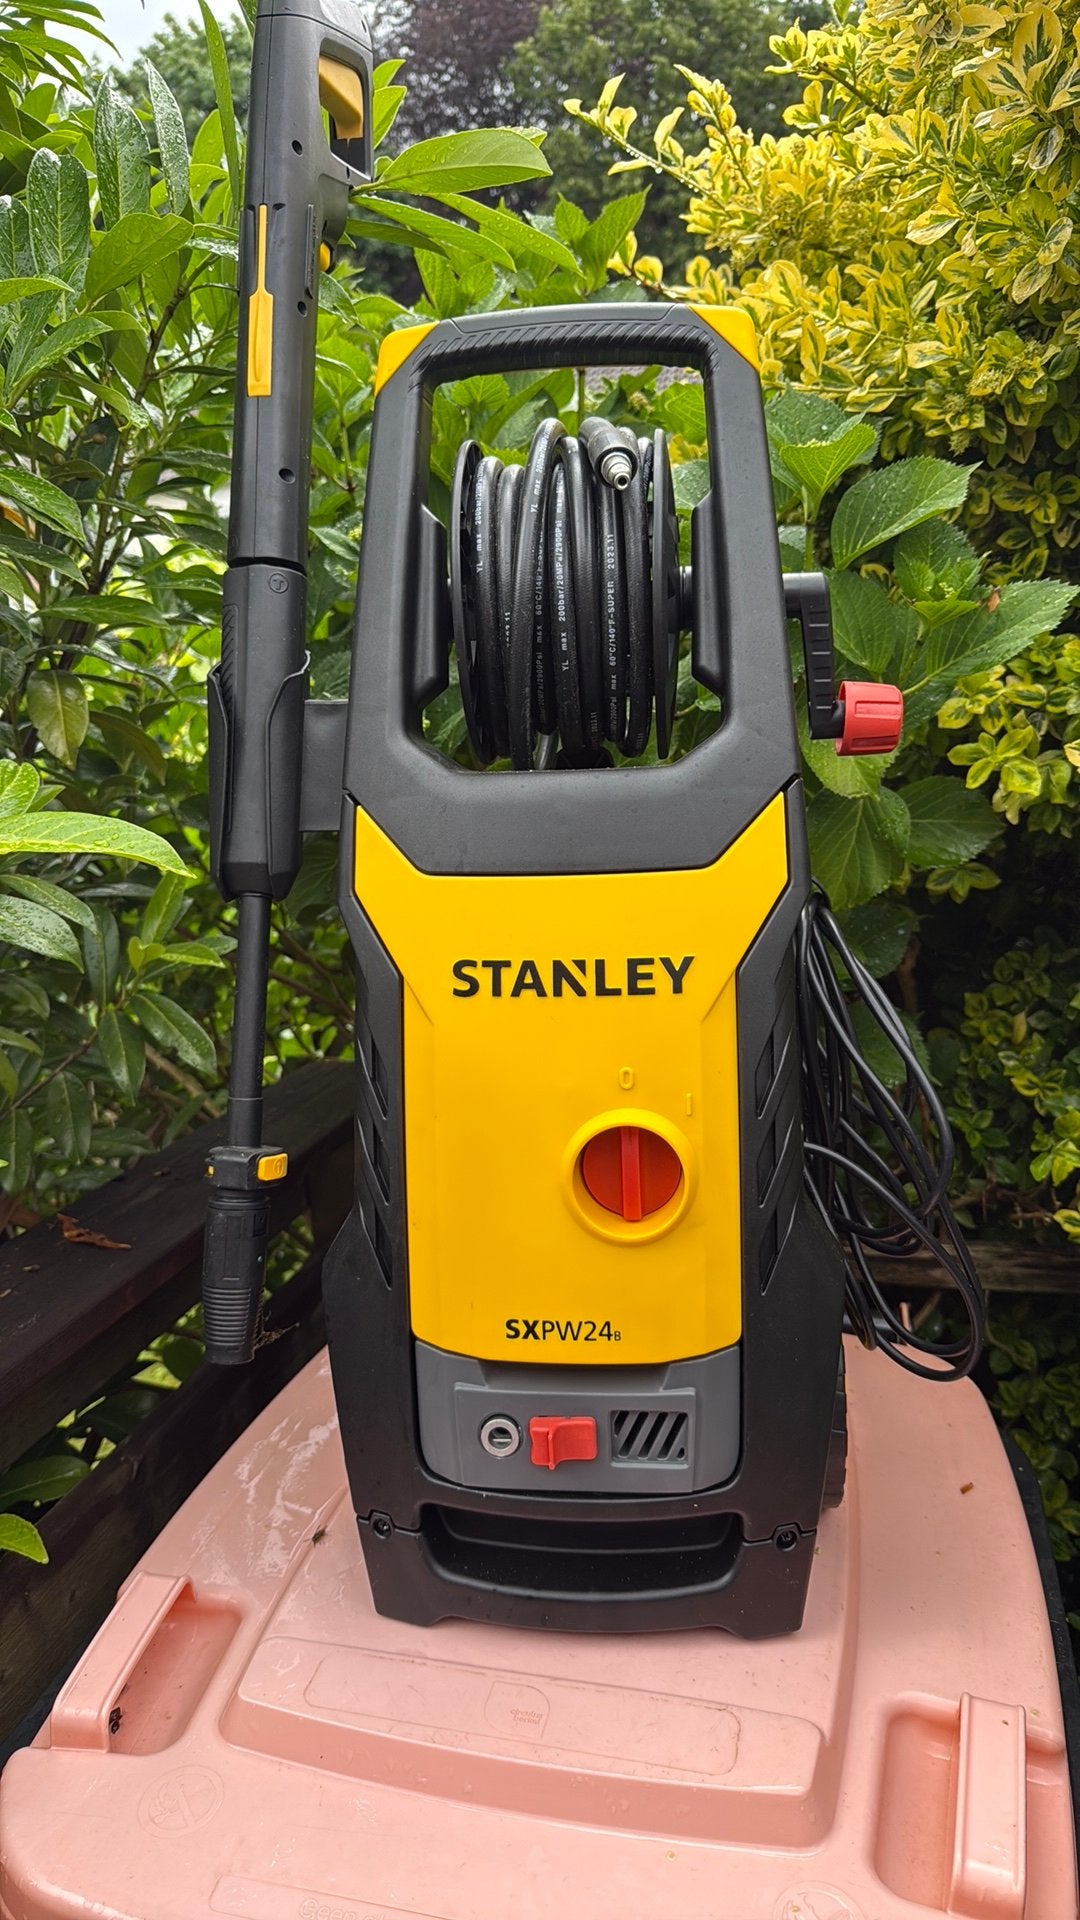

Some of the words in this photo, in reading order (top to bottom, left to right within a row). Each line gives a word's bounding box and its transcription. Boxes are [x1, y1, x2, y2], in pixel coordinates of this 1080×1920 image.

[533, 480, 542, 495] max
[531, 503, 539, 513] YL
[607, 533, 615, 570] 2023.11
[476, 560, 483, 573] YL
[560, 631, 568, 651] max
[562, 659, 569, 671] YL
[452, 956, 695, 998] STANLEY
